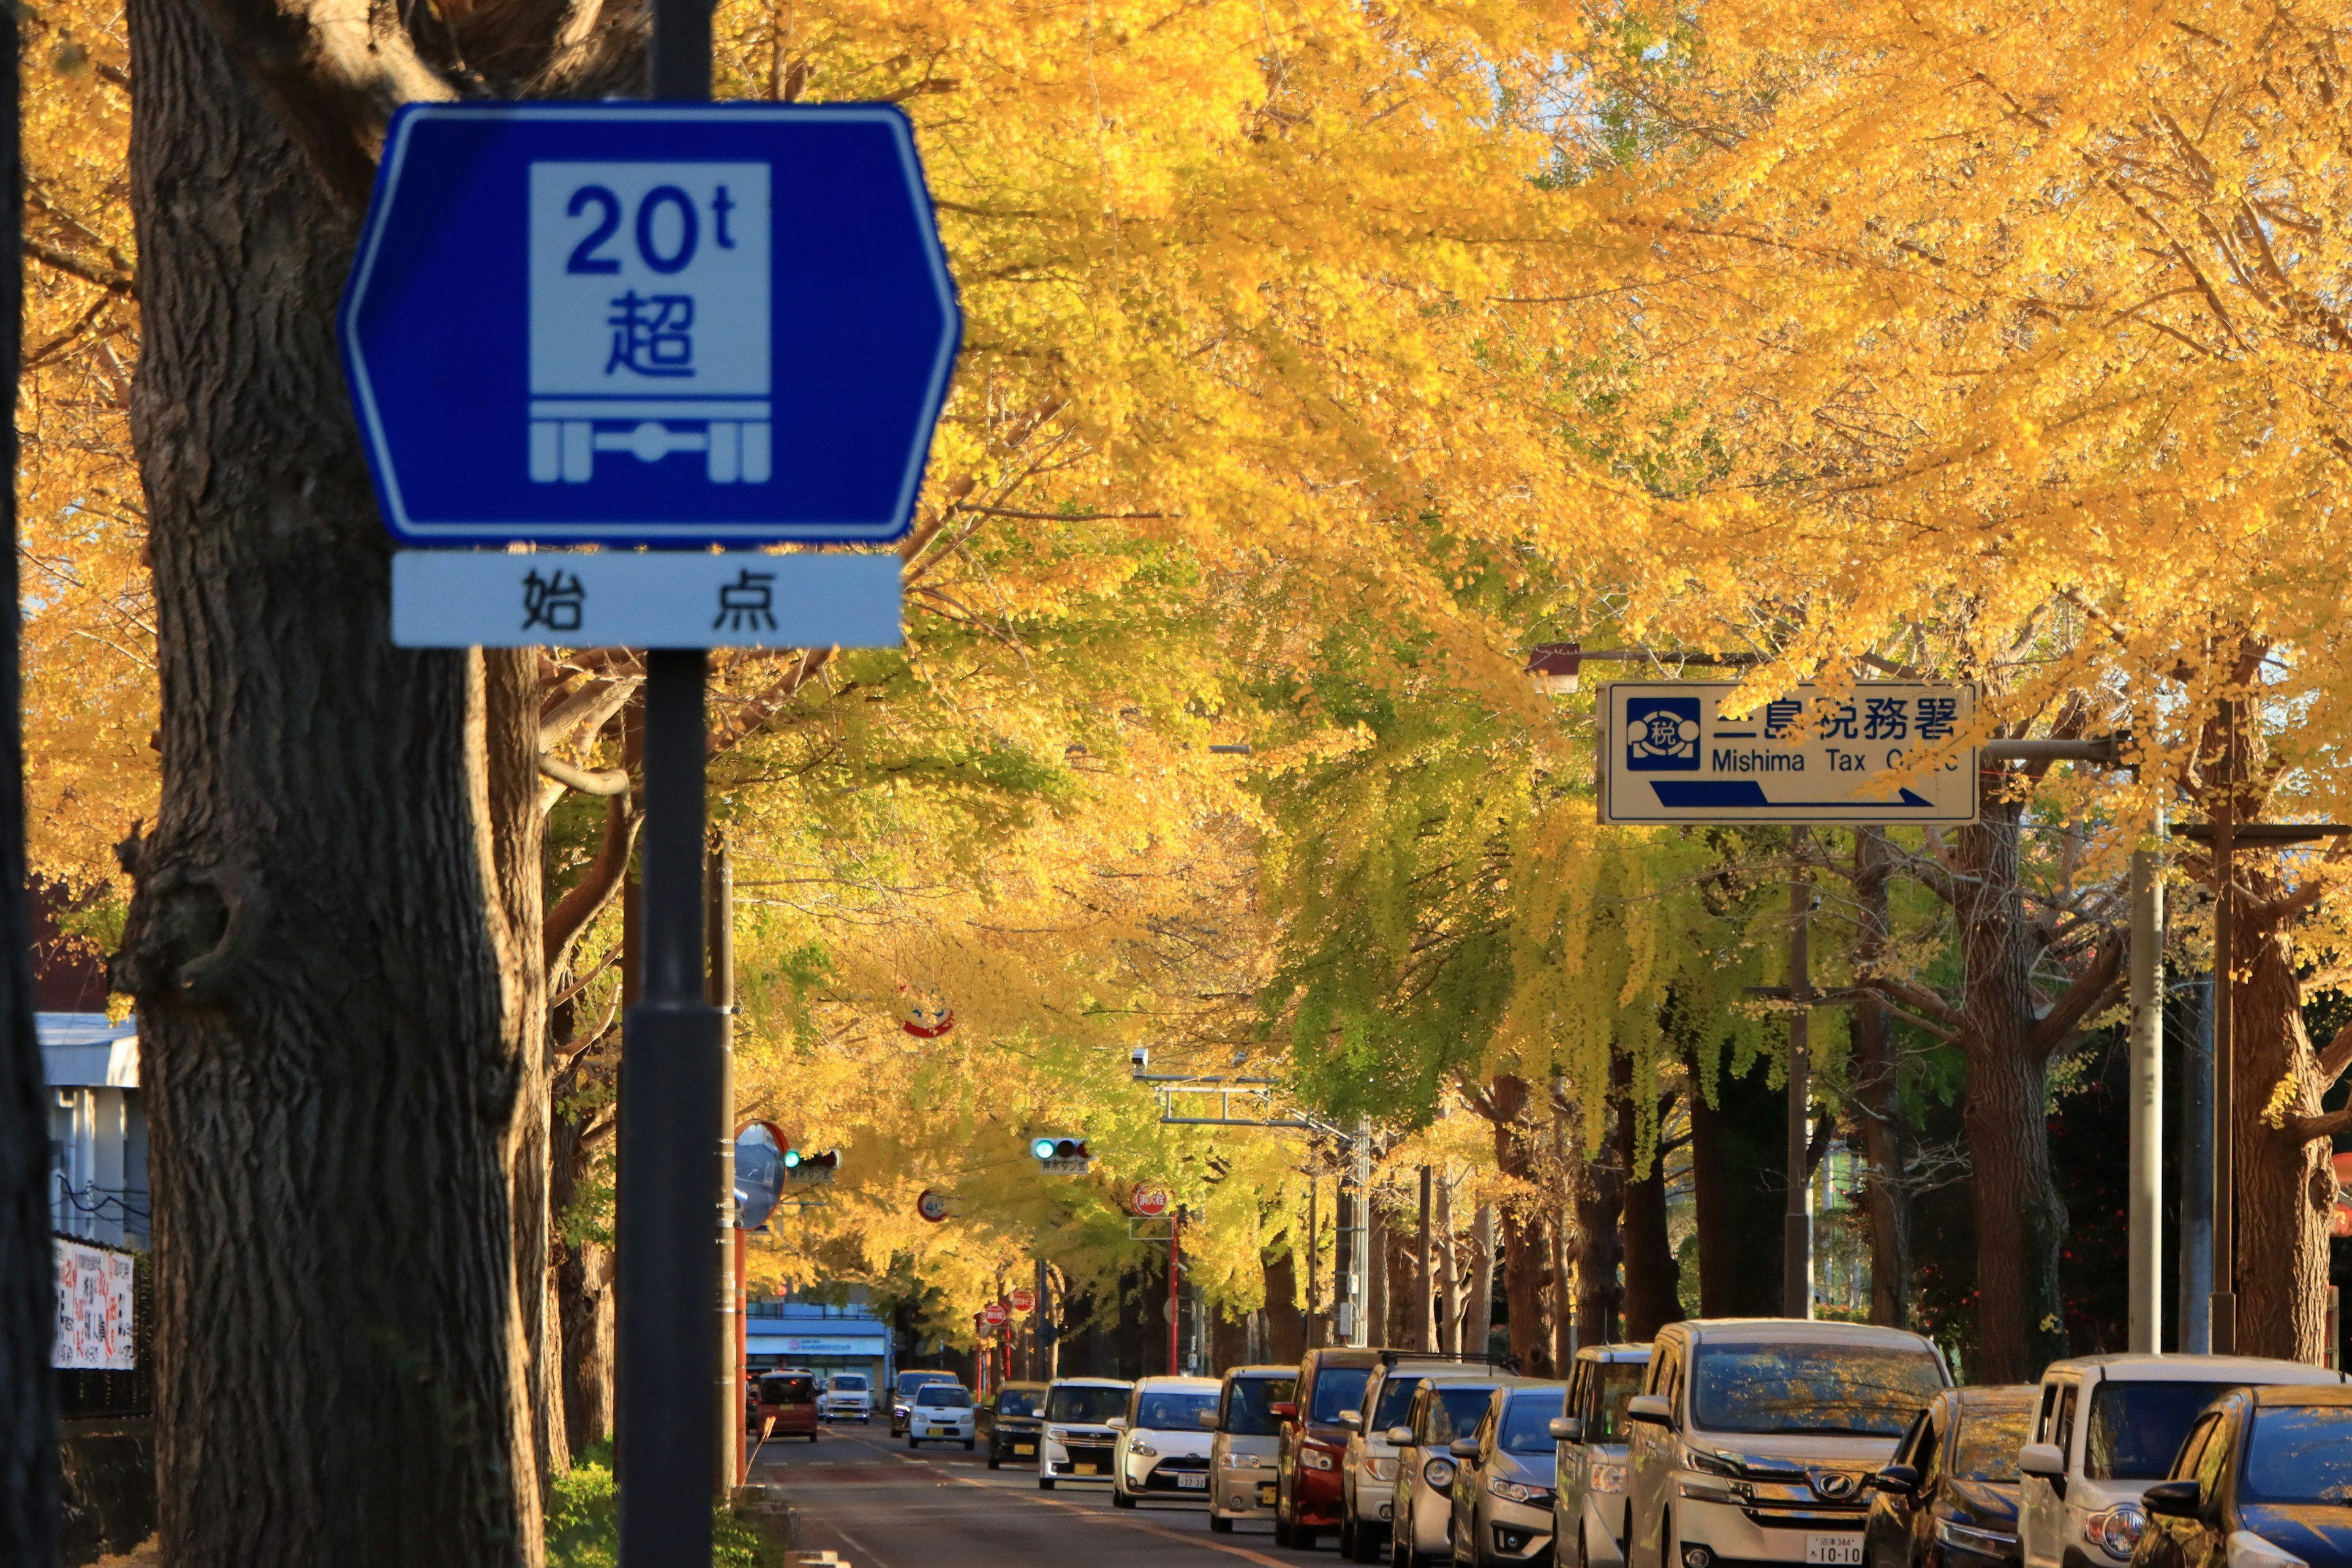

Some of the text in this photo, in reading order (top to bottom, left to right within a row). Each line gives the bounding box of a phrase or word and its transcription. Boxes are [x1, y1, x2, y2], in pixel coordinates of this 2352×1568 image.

[567, 184, 736, 274] 20t
[605, 290, 696, 378] 超
[1651, 722, 1676, 746] 税
[1713, 749, 1804, 772] Mishima
[1825, 749, 1866, 772] Tax
[1820, 1547, 1860, 1562] 10-10
